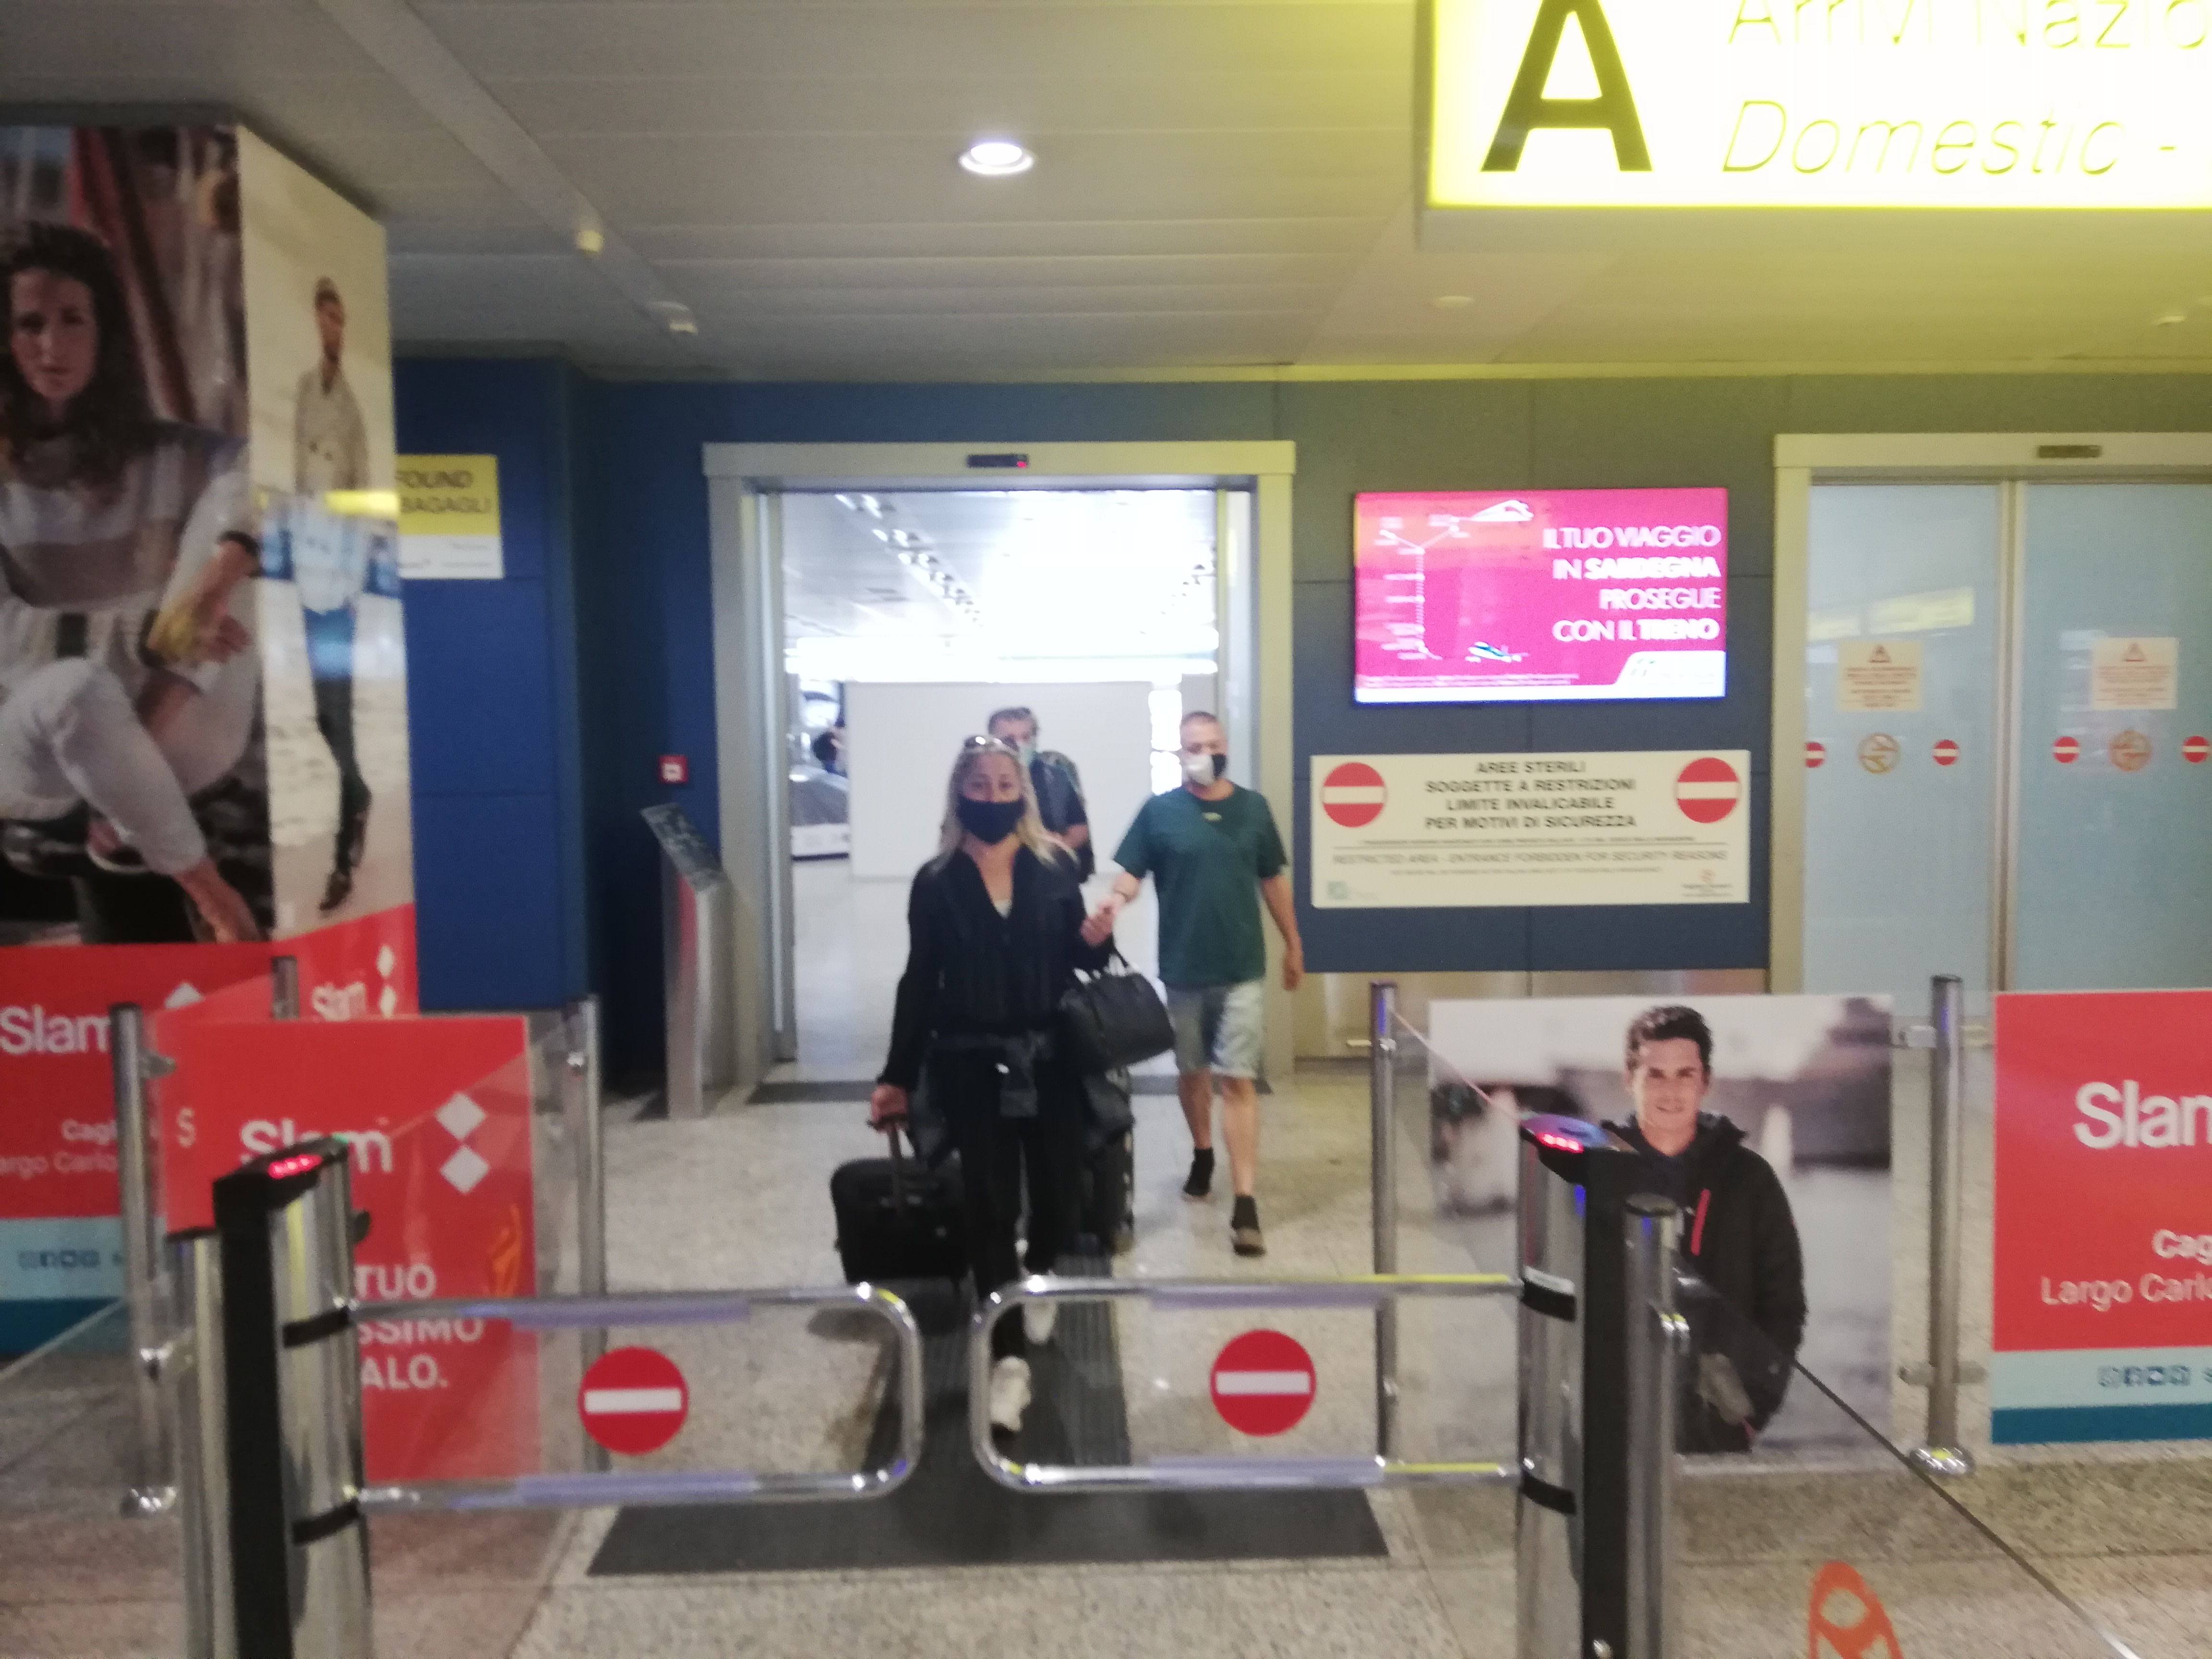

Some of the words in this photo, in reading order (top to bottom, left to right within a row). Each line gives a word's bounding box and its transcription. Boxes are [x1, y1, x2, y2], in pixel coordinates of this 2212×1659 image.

[1480, 0, 1654, 172] A
[1722, 100, 2128, 174] Domestic
[1560, 526, 1613, 548] TUO
[1614, 525, 1722, 547] VIAGGIO
[1552, 558, 1582, 579] IN
[1584, 556, 1722, 579] SARDEGNA
[1599, 587, 1722, 610] PROSEGUE
[1552, 619, 1615, 642] CON
[1636, 618, 1720, 641] TRENO
[1476, 761, 1519, 774] AREE
[1524, 760, 1586, 773] STERILI
[1425, 780, 1512, 793] SOGGETTE
[1534, 778, 1636, 792] RESTRIZIONI
[1446, 798, 1500, 811] LIMITE
[1506, 796, 1615, 810] INVALICABILE
[1425, 817, 1457, 830] PER
[1462, 816, 1519, 829] MOTIVI
[1524, 816, 1540, 828] DI
[1544, 815, 1637, 828] SICUREZZA
[241, 1118, 392, 1174] Slm
[2041, 1275, 2133, 1312] Largo
[2139, 1273, 2212, 1303] Carl
